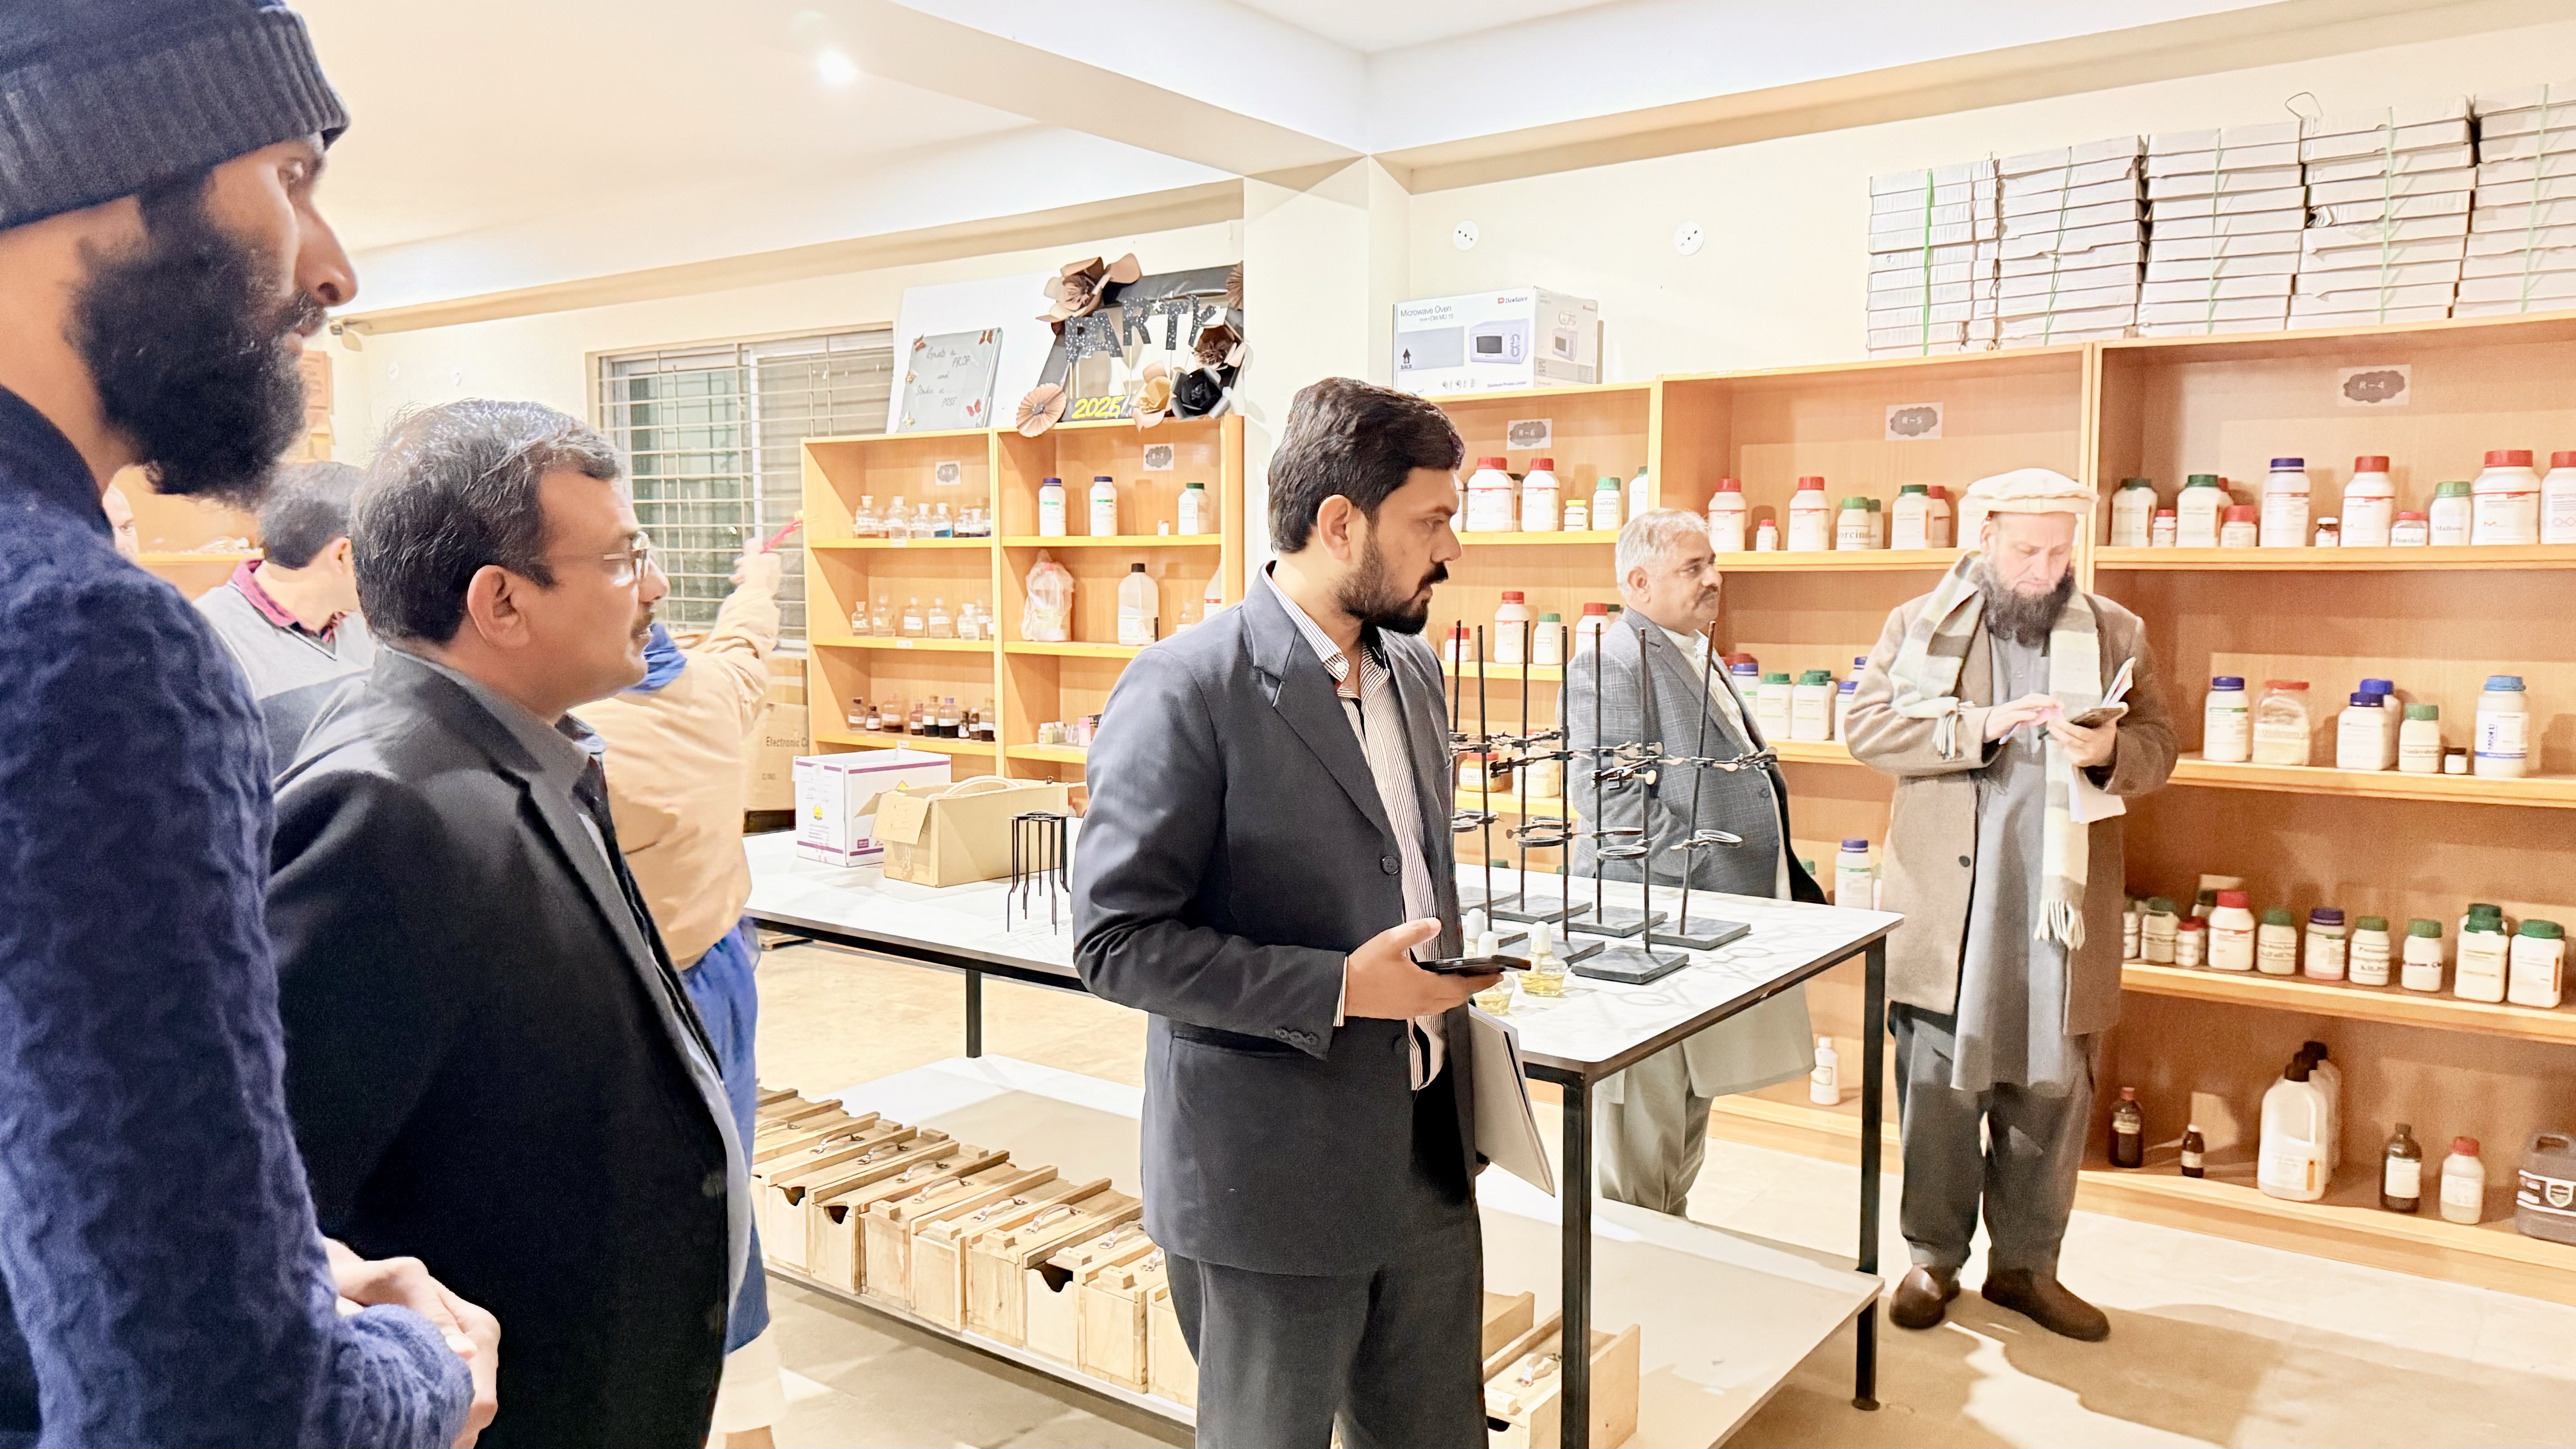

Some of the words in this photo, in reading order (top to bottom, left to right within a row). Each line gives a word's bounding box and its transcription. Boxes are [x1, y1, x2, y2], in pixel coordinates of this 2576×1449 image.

[1400, 308, 1433, 317] Microwave
[1065, 294, 1218, 362] PARTY
[1071, 396, 1125, 419] 2025
